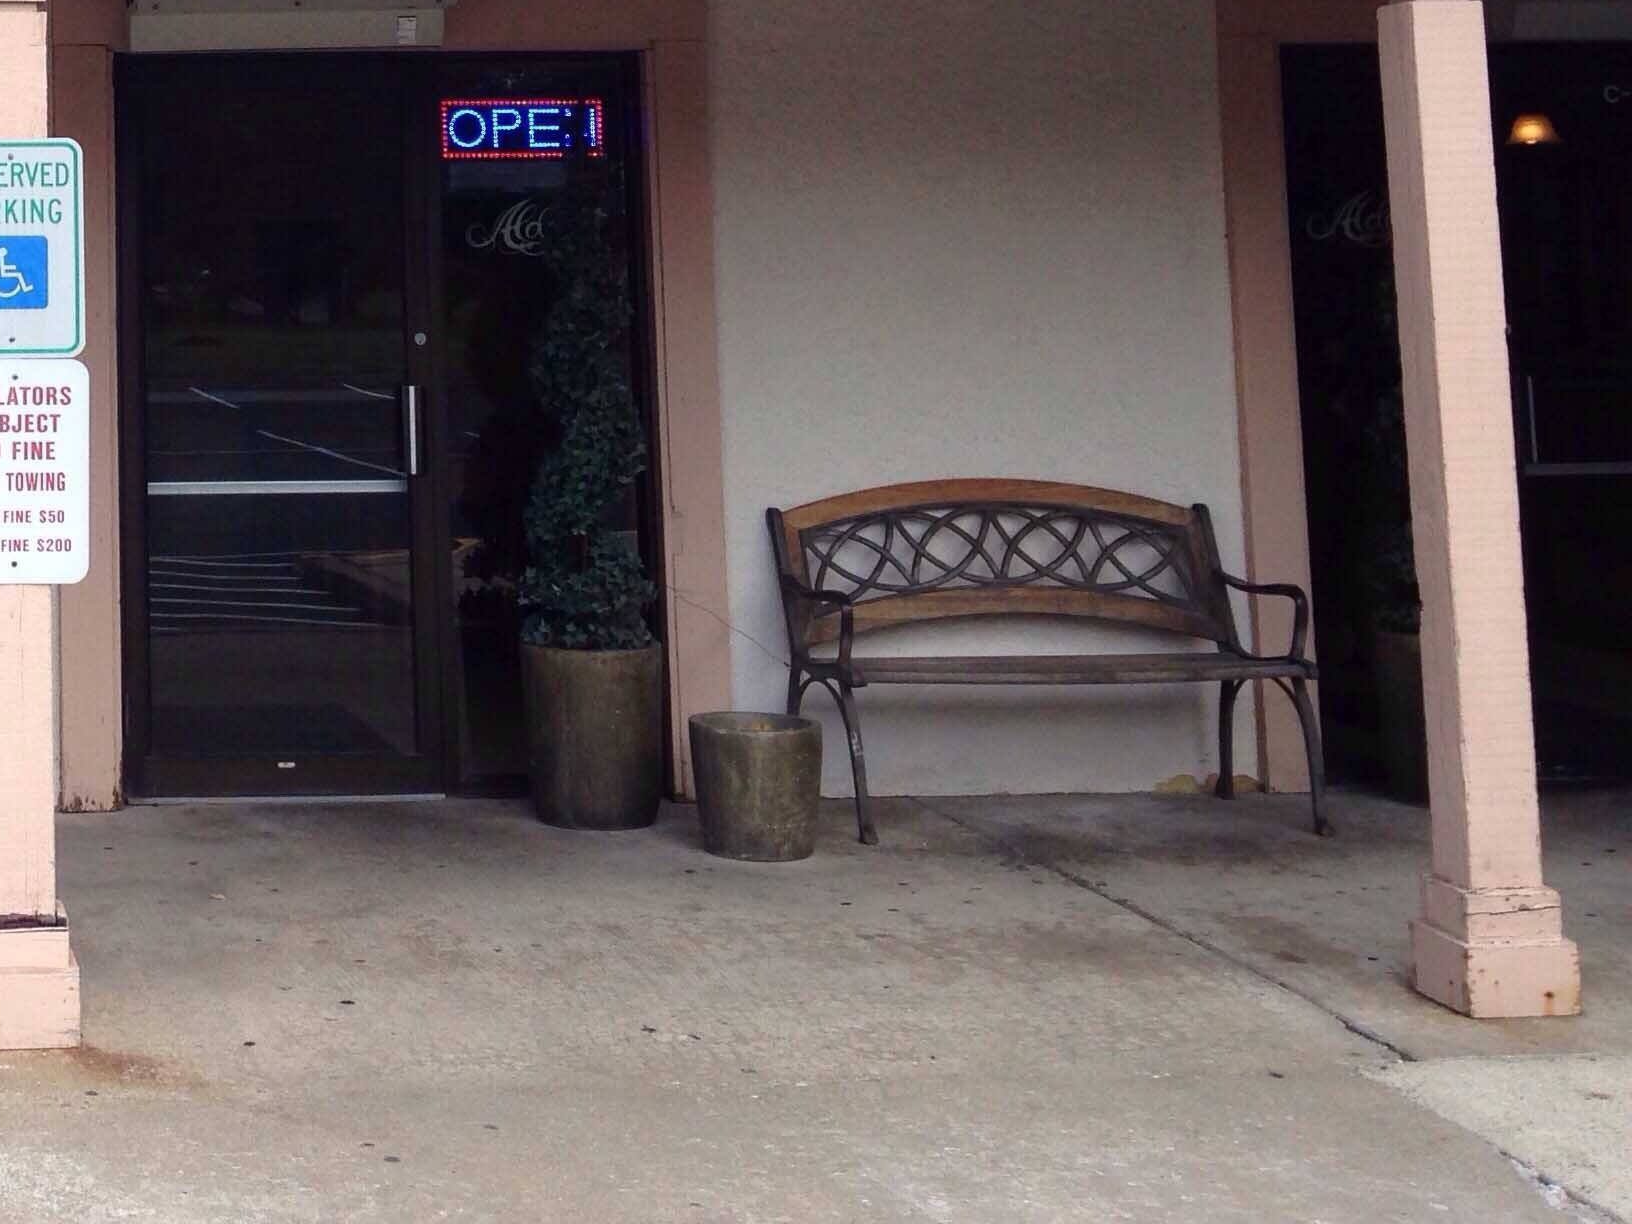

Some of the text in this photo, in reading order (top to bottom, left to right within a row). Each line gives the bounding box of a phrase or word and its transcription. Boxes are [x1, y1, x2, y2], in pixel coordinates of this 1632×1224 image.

[11, 440, 56, 461] FINE
[5, 471, 66, 492] TOWING
[3, 509, 33, 524] FINE
[39, 509, 65, 524] $50
[0, 538, 30, 553] FINE
[36, 538, 72, 553] $200
